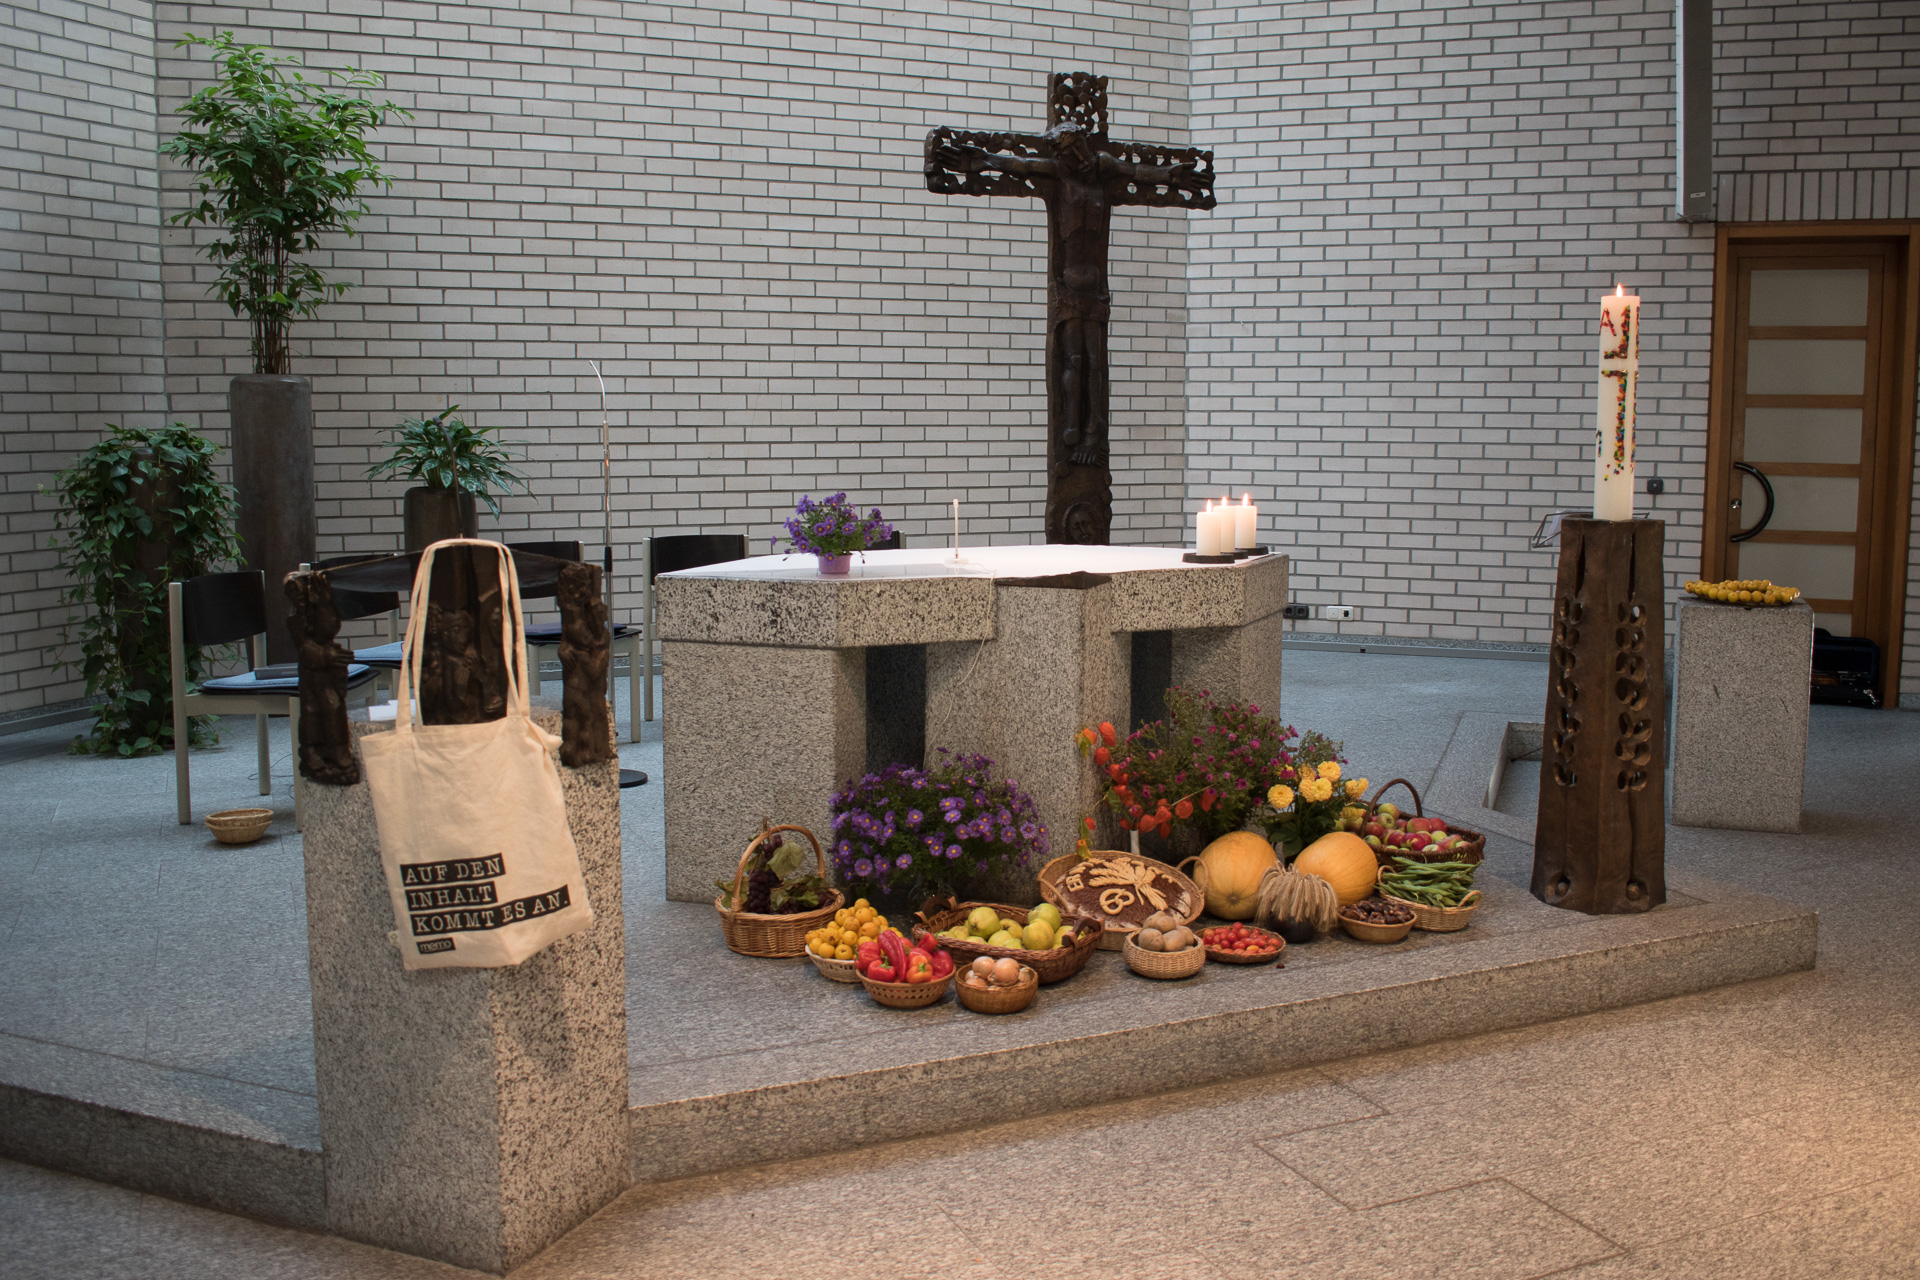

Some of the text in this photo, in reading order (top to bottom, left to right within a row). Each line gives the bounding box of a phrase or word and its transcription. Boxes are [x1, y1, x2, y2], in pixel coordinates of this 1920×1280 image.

[405, 857, 501, 884] AUF DEN
[409, 885, 493, 908] INHALT
[414, 892, 568, 933] KOMMT ES AN.
[420, 940, 452, 952] memo
